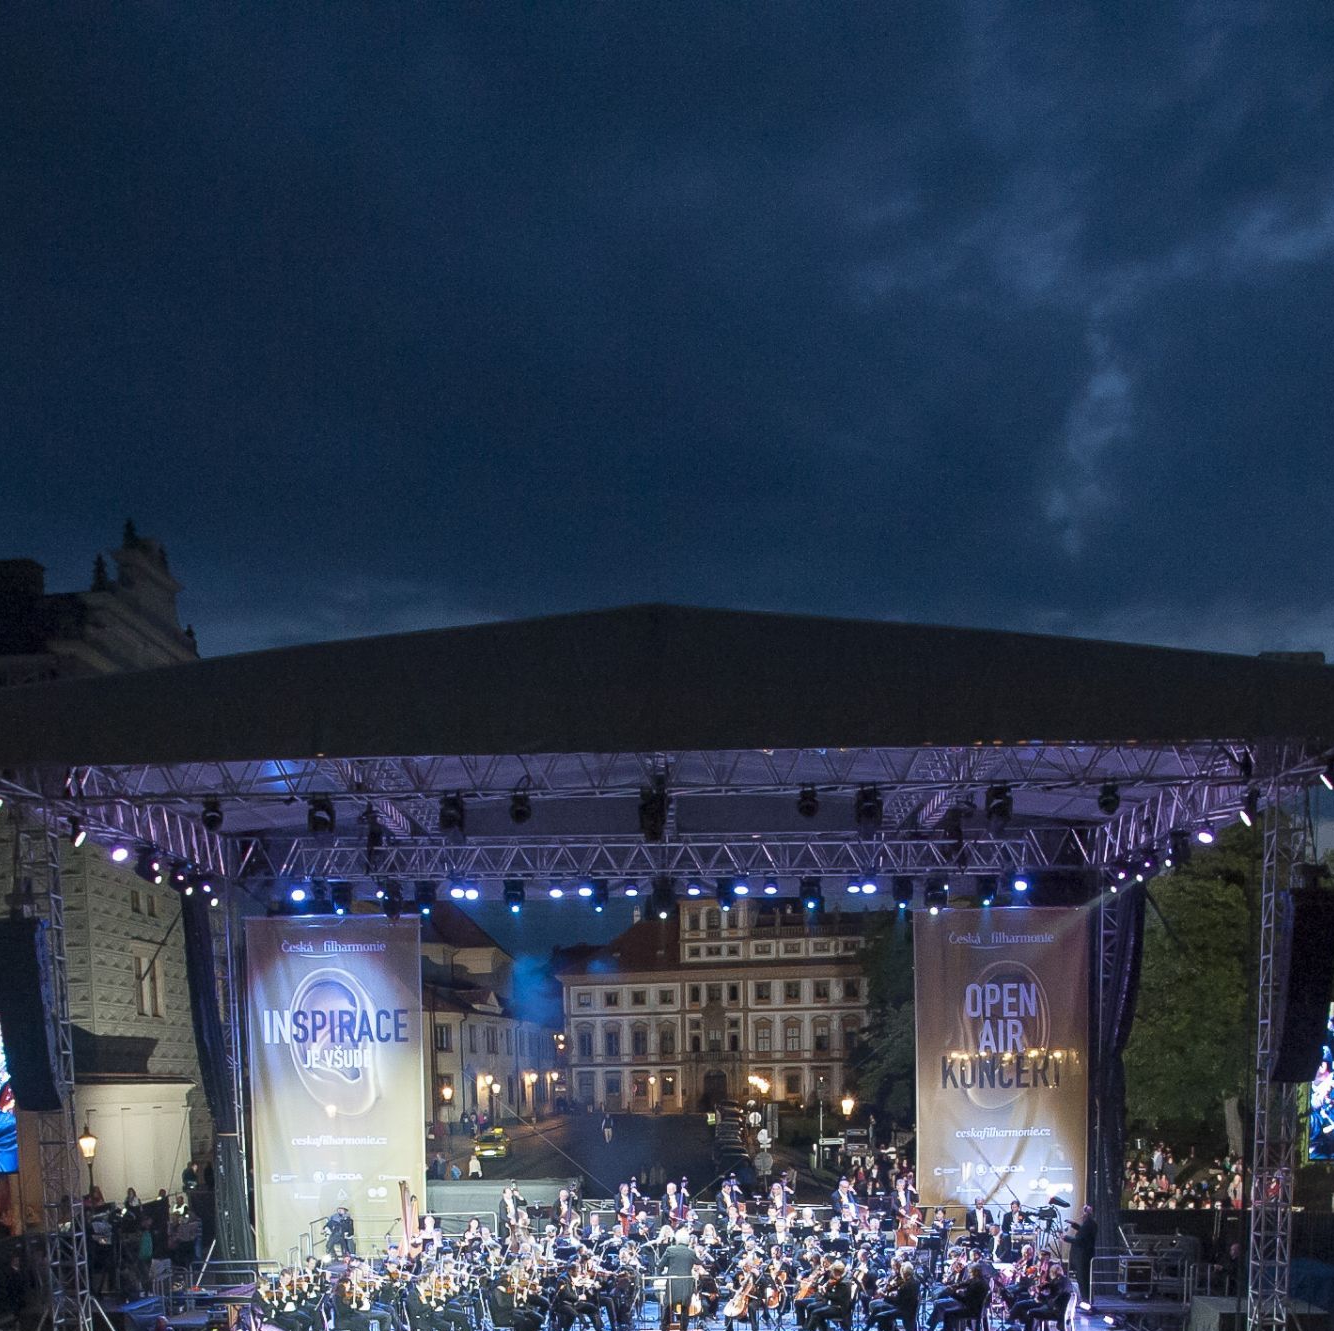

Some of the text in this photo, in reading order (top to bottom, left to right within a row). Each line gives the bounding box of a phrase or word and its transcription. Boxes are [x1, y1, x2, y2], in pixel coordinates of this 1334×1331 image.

[281, 940, 386, 952] Česká filharmonie
[948, 931, 1054, 944] Česká filharmonie
[966, 983, 1037, 1018] OPEN
[264, 1009, 409, 1044] INSPIRACE
[978, 1019, 1024, 1054] AIR
[955, 1127, 1051, 1140] ceskafilharmonie.cz
